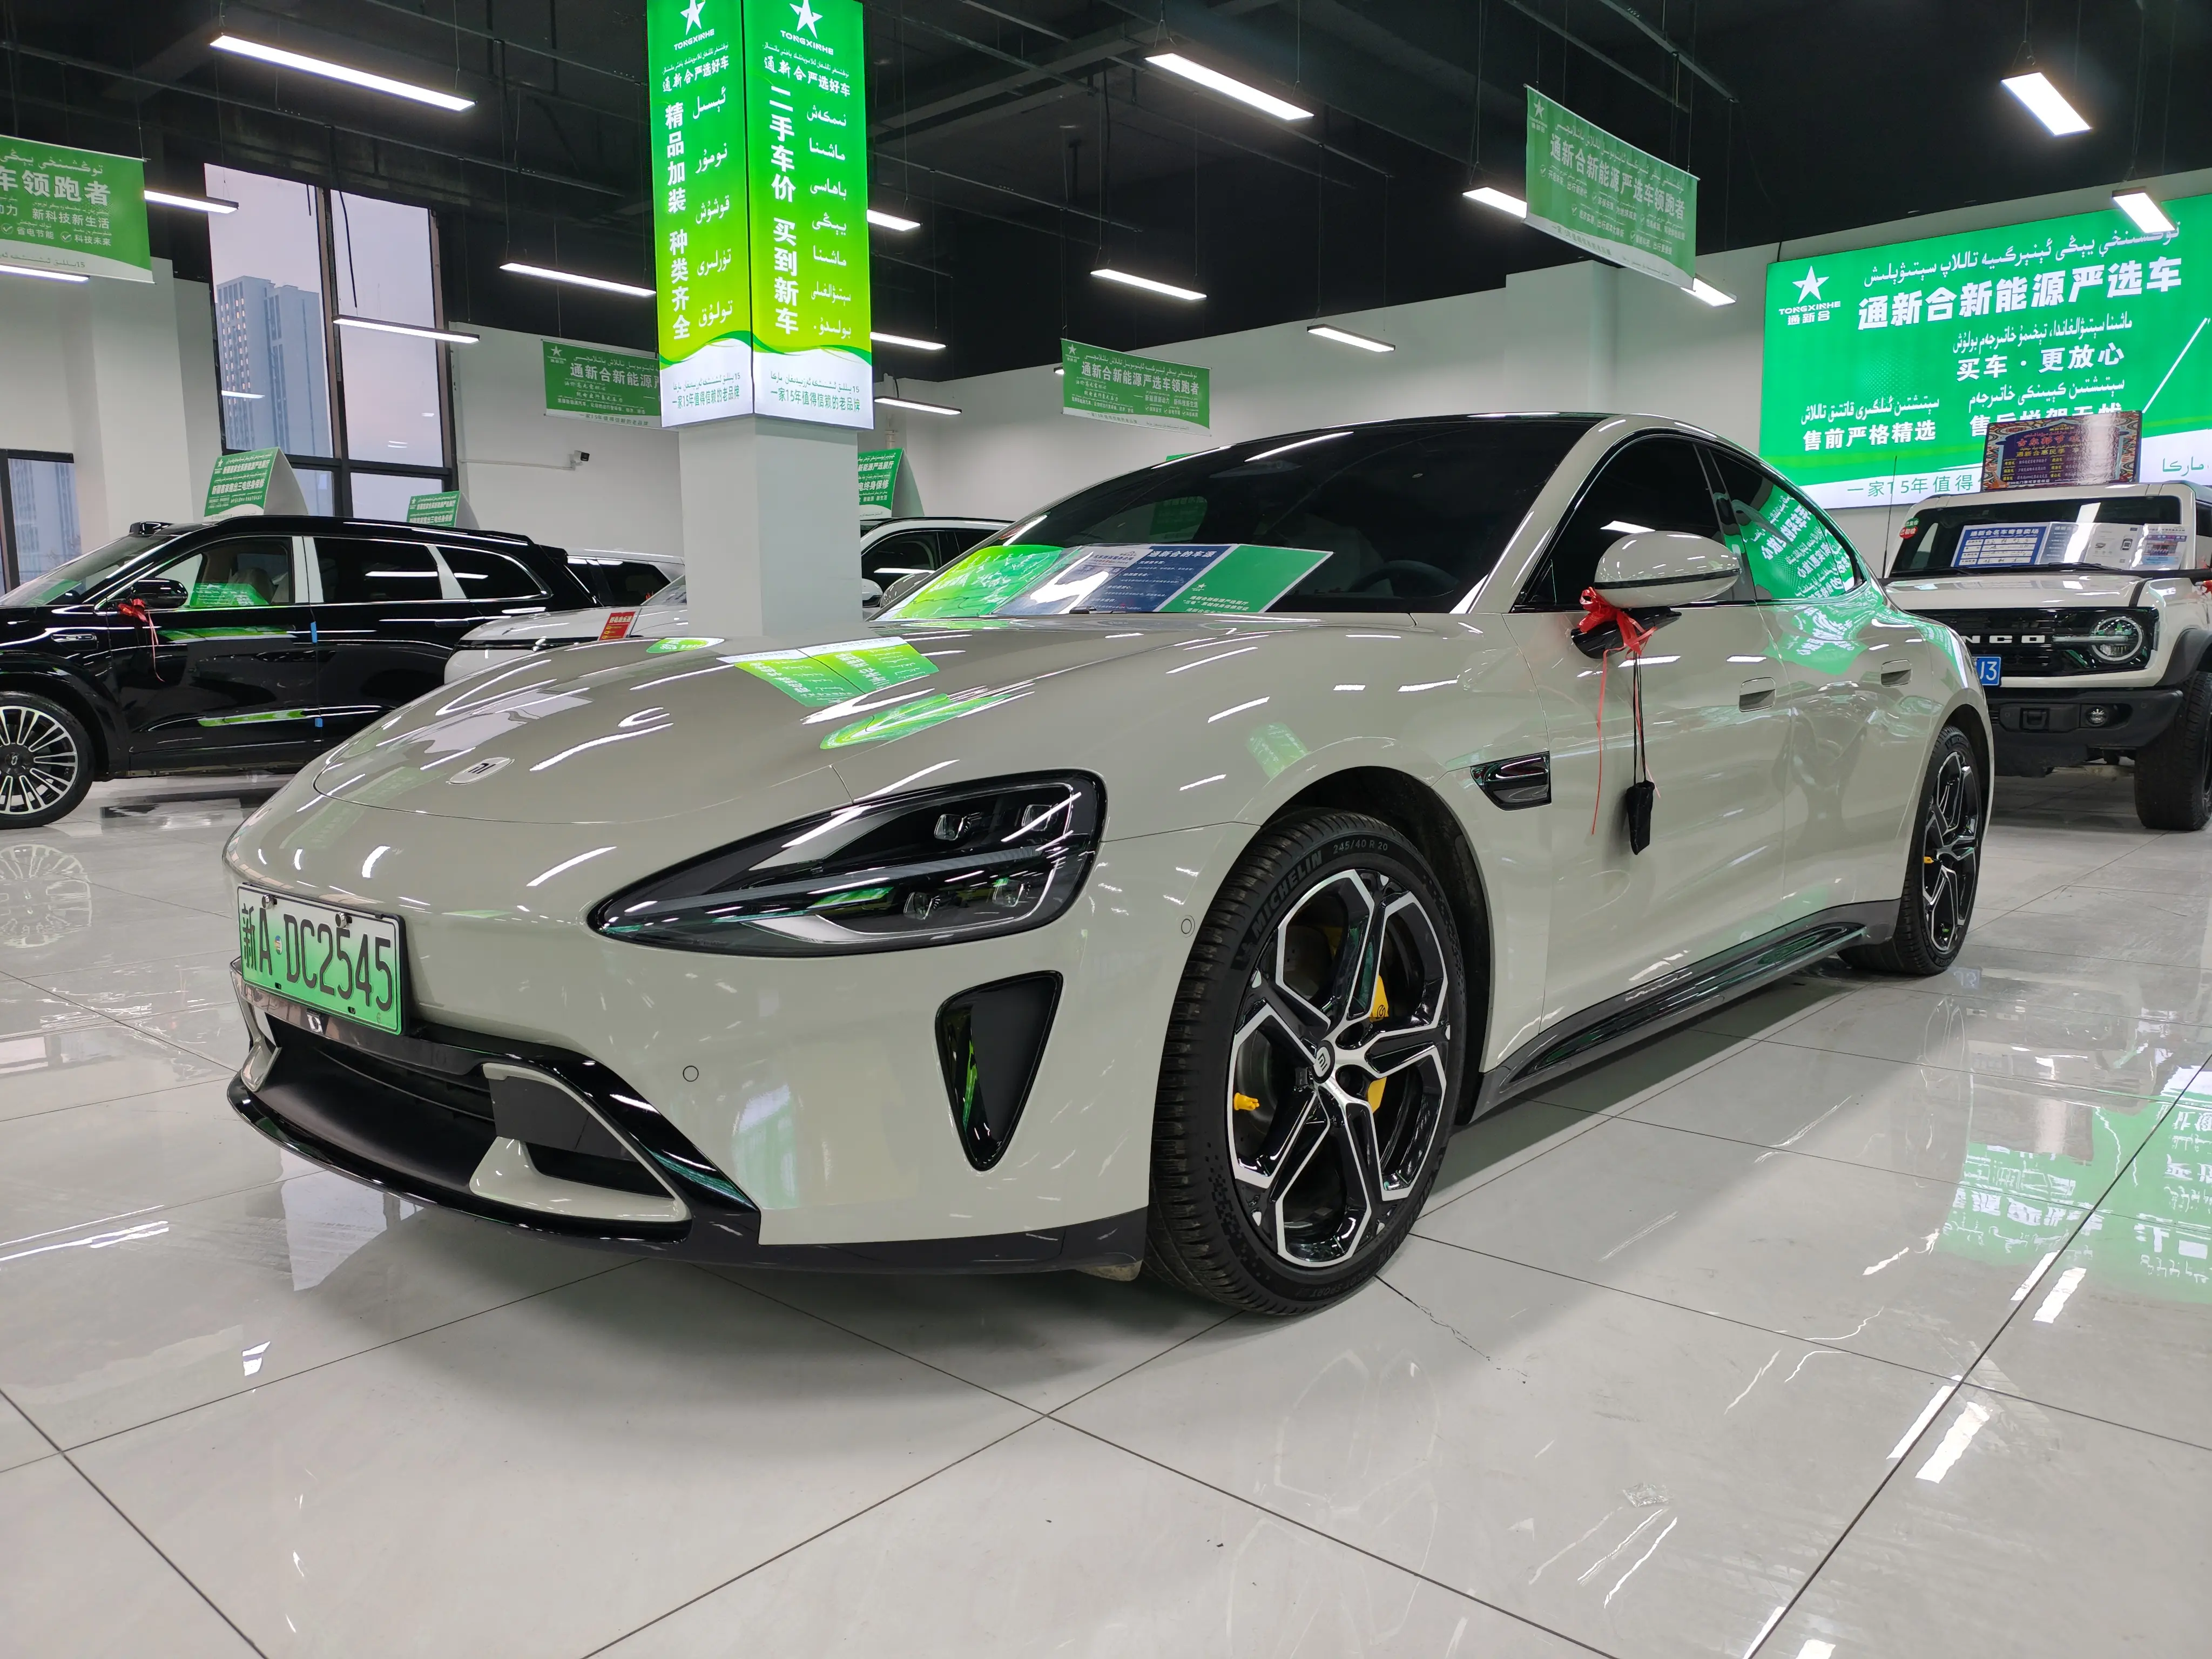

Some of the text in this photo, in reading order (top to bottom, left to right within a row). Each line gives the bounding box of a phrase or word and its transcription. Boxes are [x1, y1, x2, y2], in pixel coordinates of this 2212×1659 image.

[674, 29, 714, 50] TONGXINHE
[780, 30, 833, 56] TONGXINHE
[663, 55, 729, 92] 通新合严选好车
[764, 56, 850, 97] 通新合严选好车
[32, 208, 109, 229] 新科技新生活
[665, 102, 690, 340] 精品加装 种类齐全
[769, 85, 799, 334] 二手车价 买到新车
[17, 227, 54, 239] 省电节能
[75, 234, 111, 246] 科技未来
[1858, 256, 2182, 331] 通新合新能源严选车
[1778, 301, 1840, 315] TONGXINHE
[1788, 311, 1830, 326] 通新合
[1082, 361, 1199, 395] 通新合新能源严选车领跑者
[672, 385, 739, 408] 一家15年值得信赖的老品牌
[771, 387, 860, 413] 一家15年值得信赖的老品牌
[1803, 420, 1936, 451] 售前严格精选
[1847, 475, 1981, 497] 一家15年值得
[1147, 550, 1217, 558] 通新合的车源
[1251, 850, 1322, 938] MICHELIN
[1333, 839, 1366, 854] 245/40
[1378, 842, 1388, 851] 20
